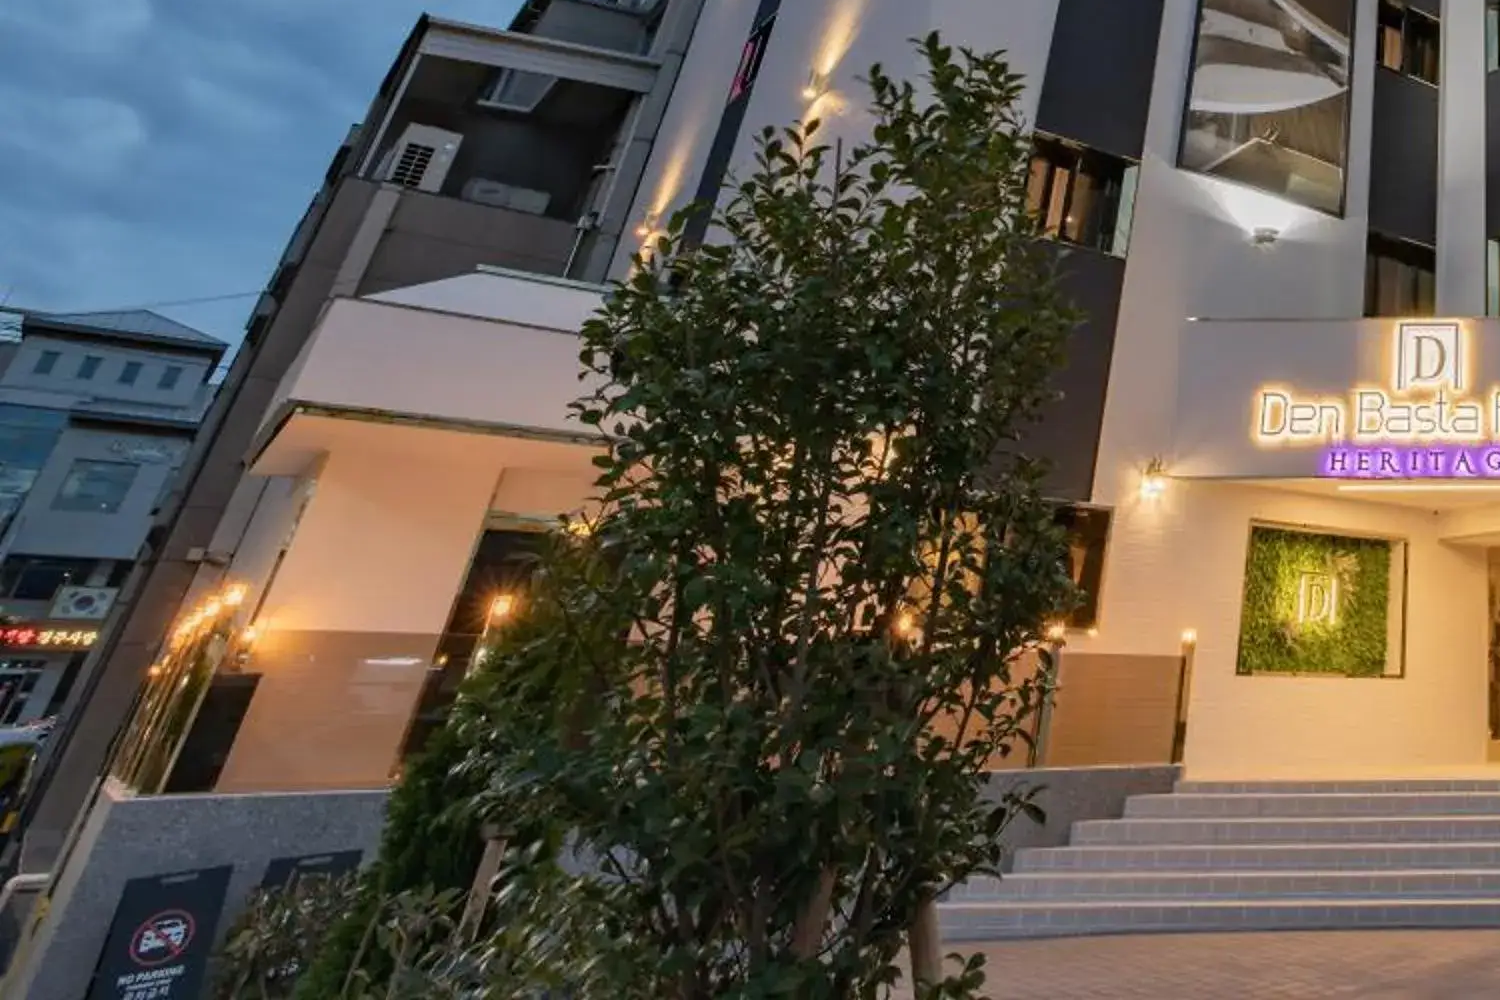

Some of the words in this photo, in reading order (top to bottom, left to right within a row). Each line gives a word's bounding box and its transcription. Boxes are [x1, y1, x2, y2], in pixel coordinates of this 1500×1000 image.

[1411, 335, 1447, 382] D
[1260, 392, 1341, 436] Den
[1357, 390, 1481, 434] Basta
